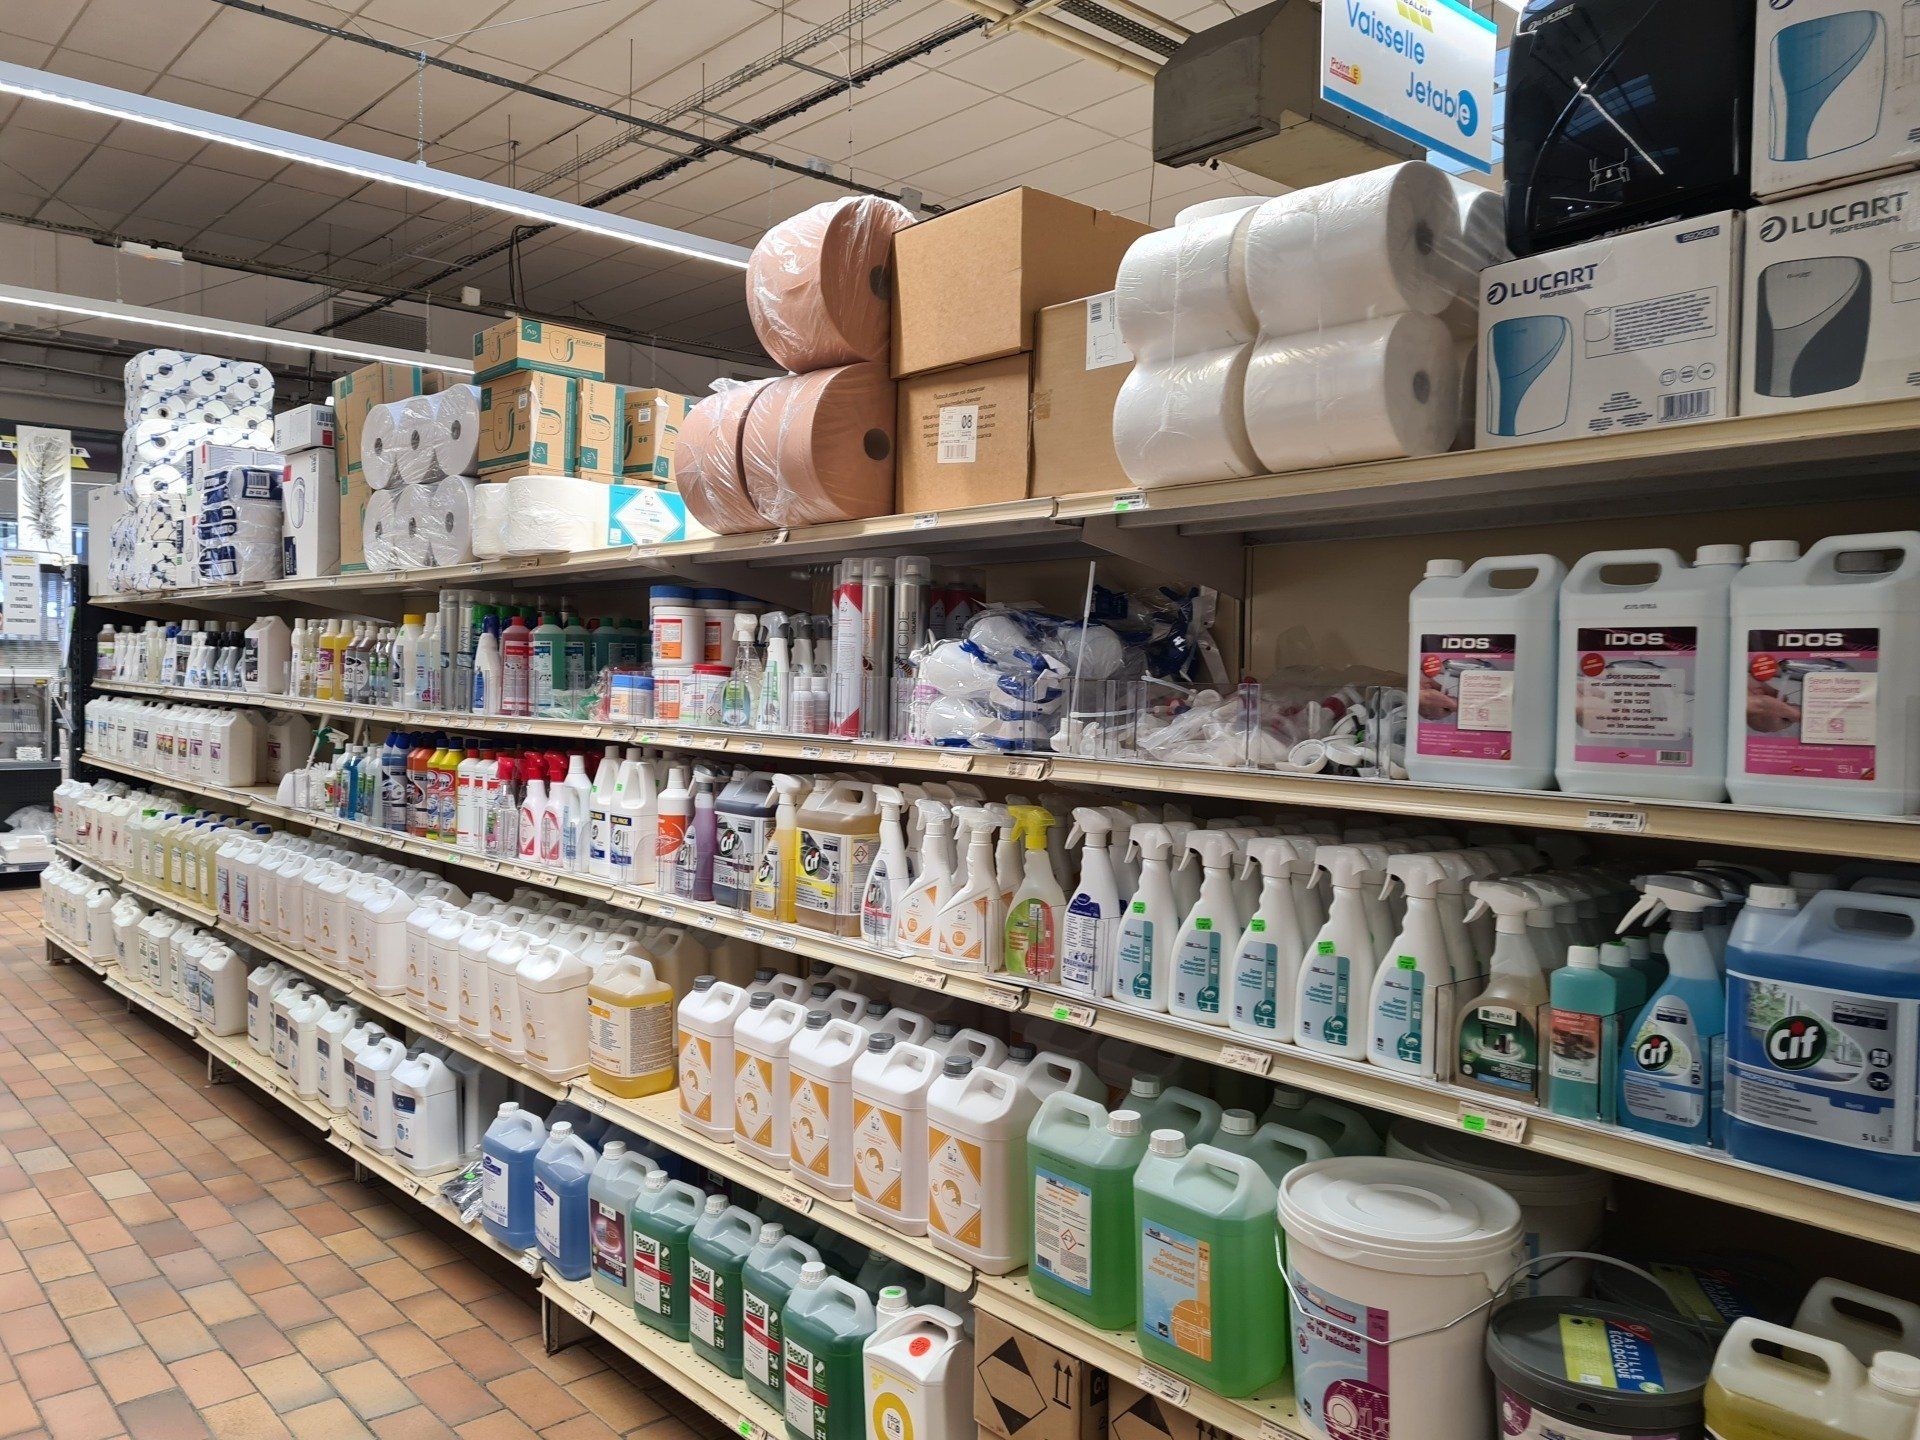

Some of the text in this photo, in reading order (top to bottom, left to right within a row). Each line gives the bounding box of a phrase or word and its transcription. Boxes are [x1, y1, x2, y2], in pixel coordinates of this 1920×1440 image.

[1346, 0, 1425, 65] Vaisselle
[1405, 71, 1472, 127] Jetable
[1792, 191, 1909, 234] LUCART
[1511, 263, 1598, 297] LUCART
[1540, 283, 1593, 299] PROFESSIONAL
[1441, 637, 1491, 649] IDOS
[1605, 632, 1664, 646] IDOS
[1777, 632, 1844, 647] IDOS
[1638, 1038, 1669, 1064] Cif
[1770, 1021, 1818, 1061] Cif
[636, 1233, 656, 1253] Teepol
[692, 1261, 711, 1281] Teepol
[746, 1293, 765, 1316] Teepol
[1325, 1333, 1361, 1355] vaisselle
[1328, 1325, 1361, 1343] lavage
[787, 1340, 810, 1367] Teepol
[1623, 1331, 1645, 1381] PASTILLE
